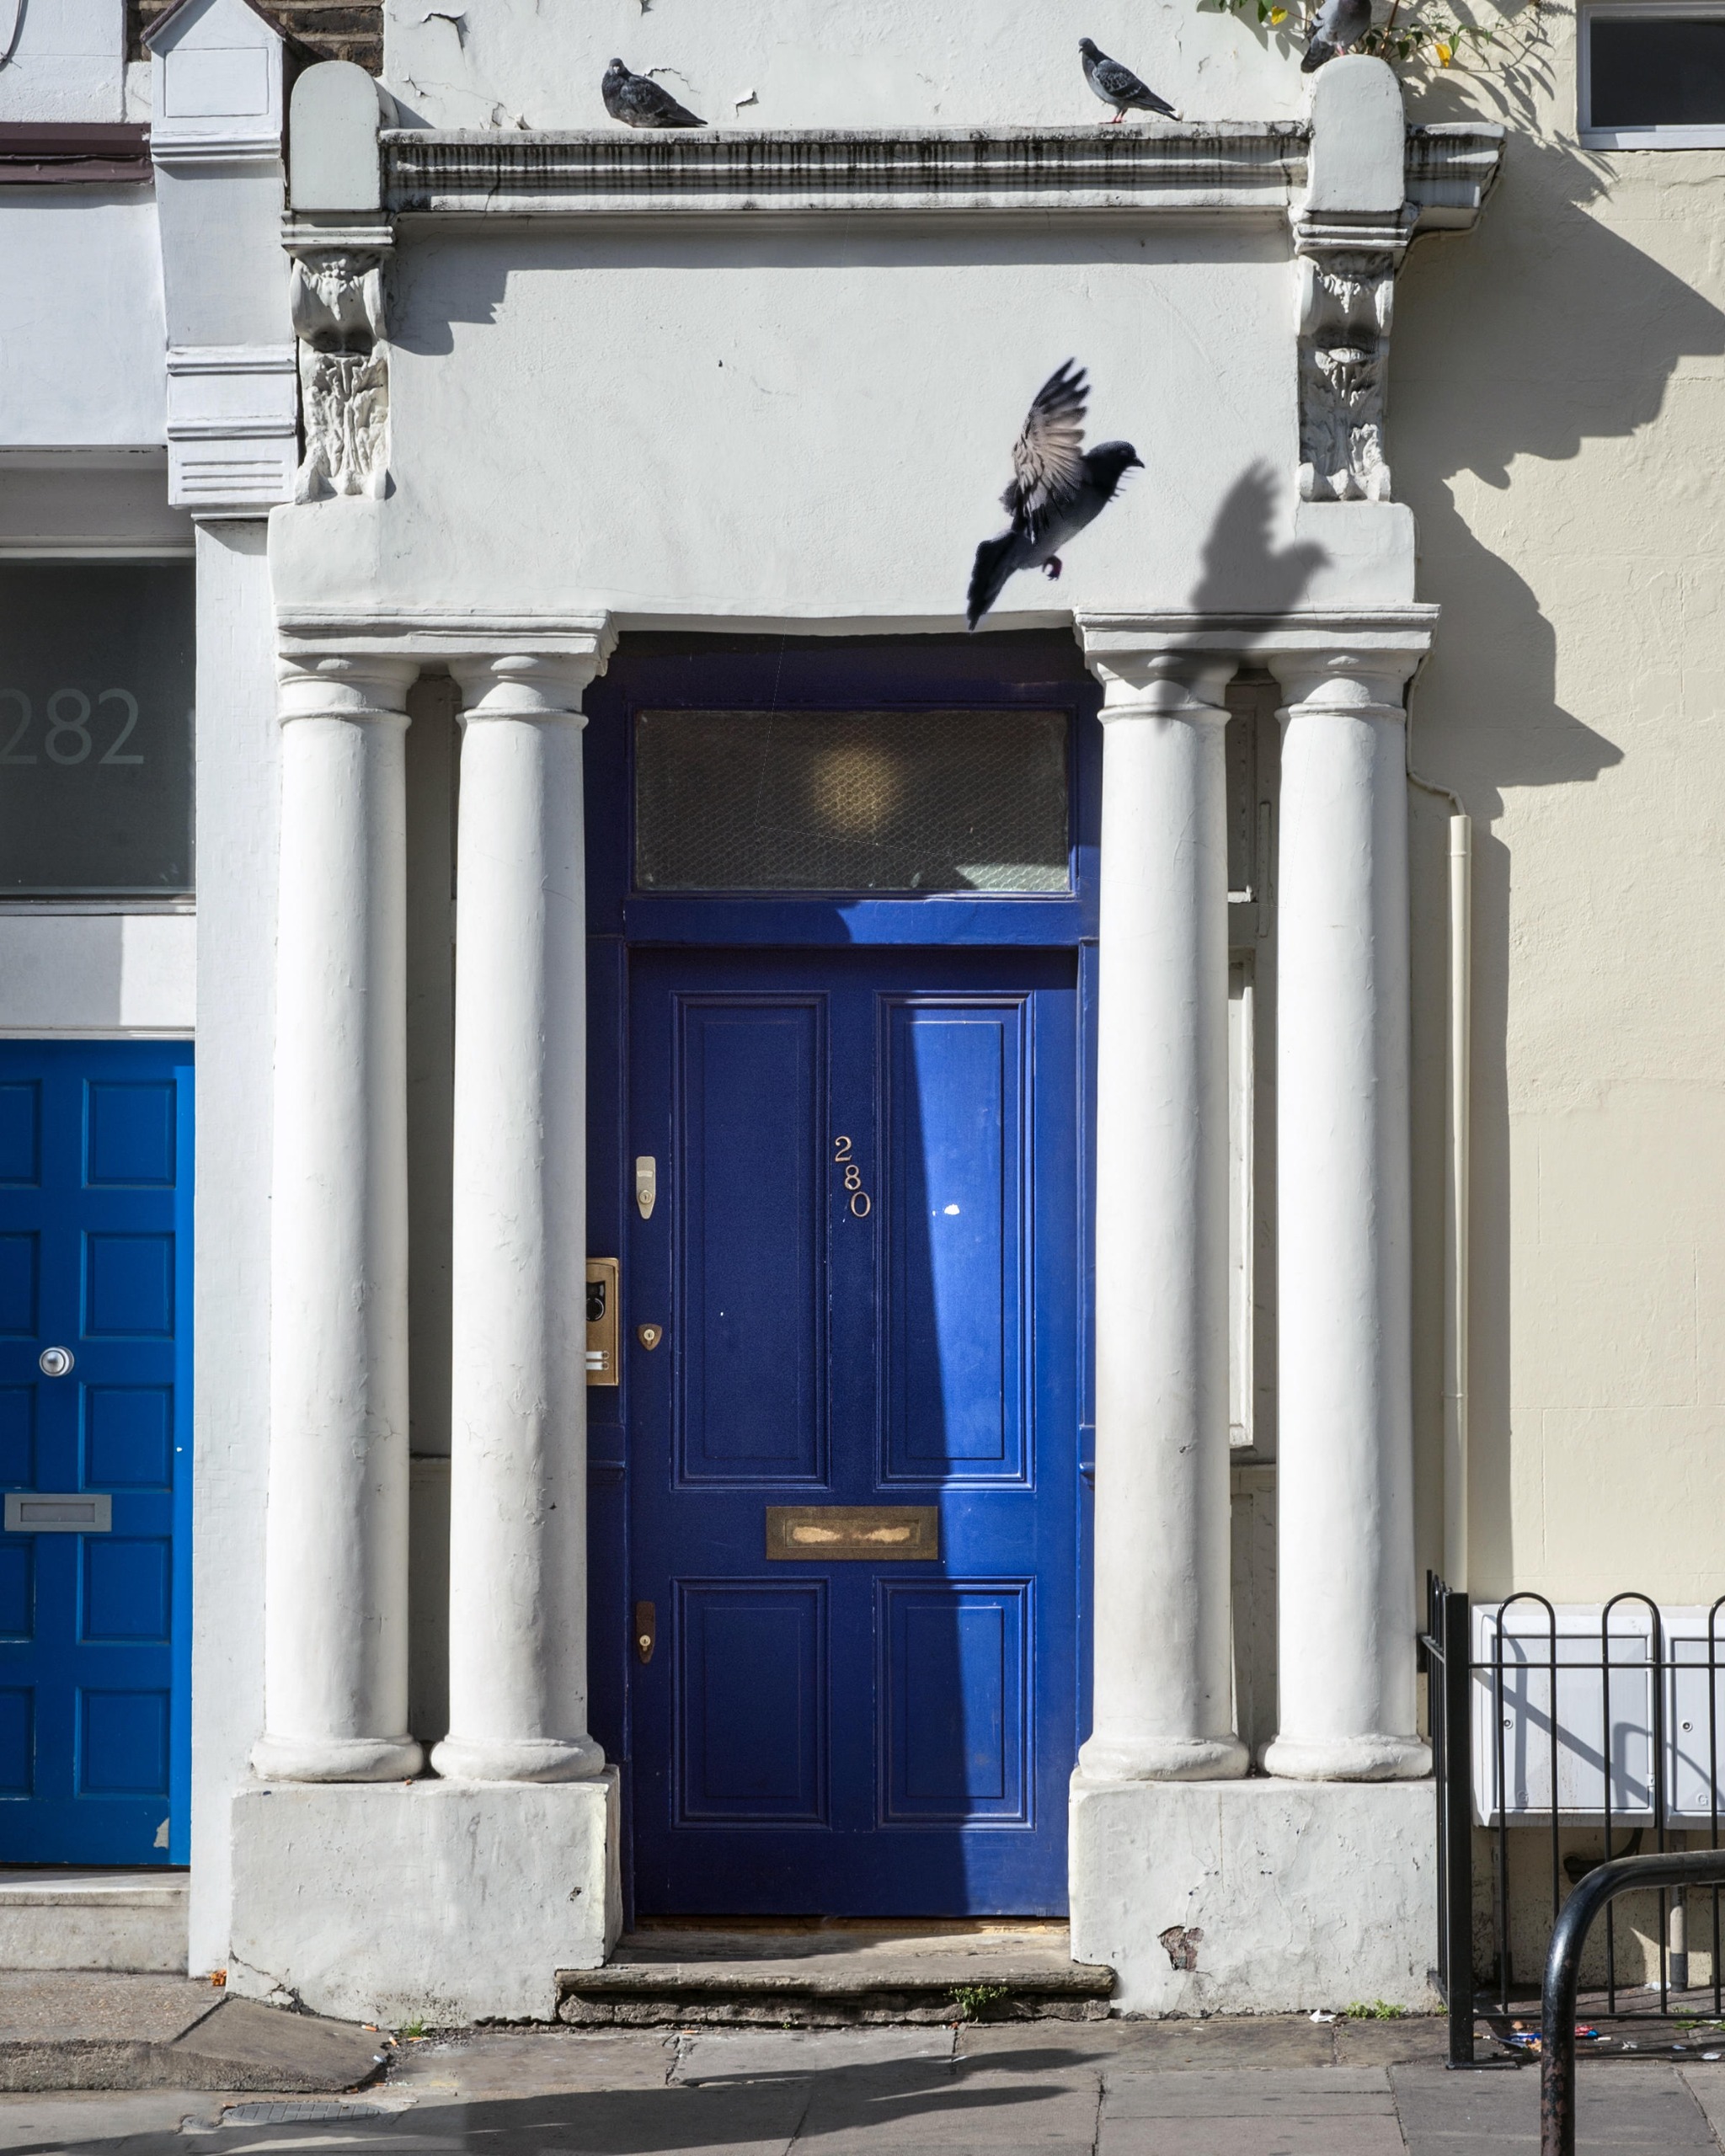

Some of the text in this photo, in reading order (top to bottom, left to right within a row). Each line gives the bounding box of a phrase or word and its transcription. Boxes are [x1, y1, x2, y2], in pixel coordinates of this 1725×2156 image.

[0, 688, 144, 765] 282
[835, 1135, 871, 1217] 280
[1696, 1793, 1708, 1806] G
